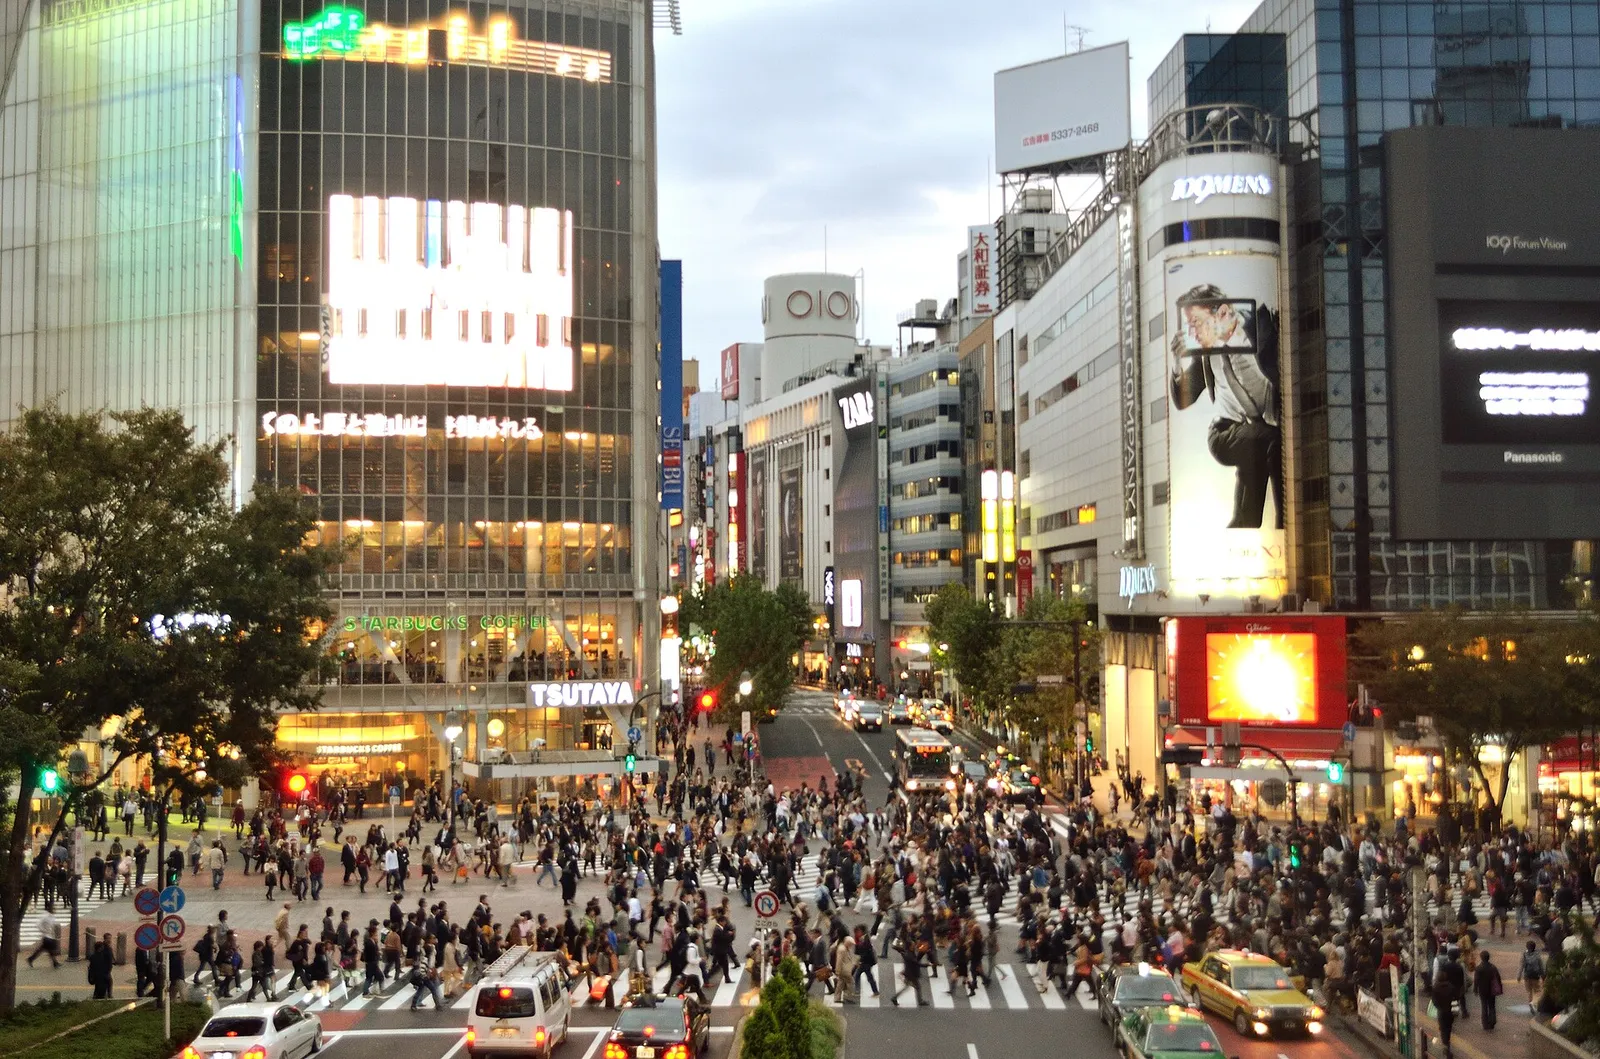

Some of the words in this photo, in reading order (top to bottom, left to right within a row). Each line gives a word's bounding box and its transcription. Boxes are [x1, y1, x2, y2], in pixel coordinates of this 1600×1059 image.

[1051, 122, 1099, 141] 5337-2468
[1120, 205, 1132, 269] THE
[1486, 235, 1511, 255] 109
[1513, 235, 1540, 249] Forum
[1540, 236, 1567, 250] Vision
[973, 231, 990, 296] 大和証券
[1124, 281, 1134, 350] SUIT
[1125, 357, 1137, 510] COMPANY
[663, 426, 681, 494] SEIBU
[1503, 450, 1563, 463] Panasonic
[344, 615, 468, 632] STARBUCKS
[530, 681, 634, 707] TSUTAYA
[316, 745, 371, 754] STARBUCKS
[371, 743, 402, 753] COFFEE
